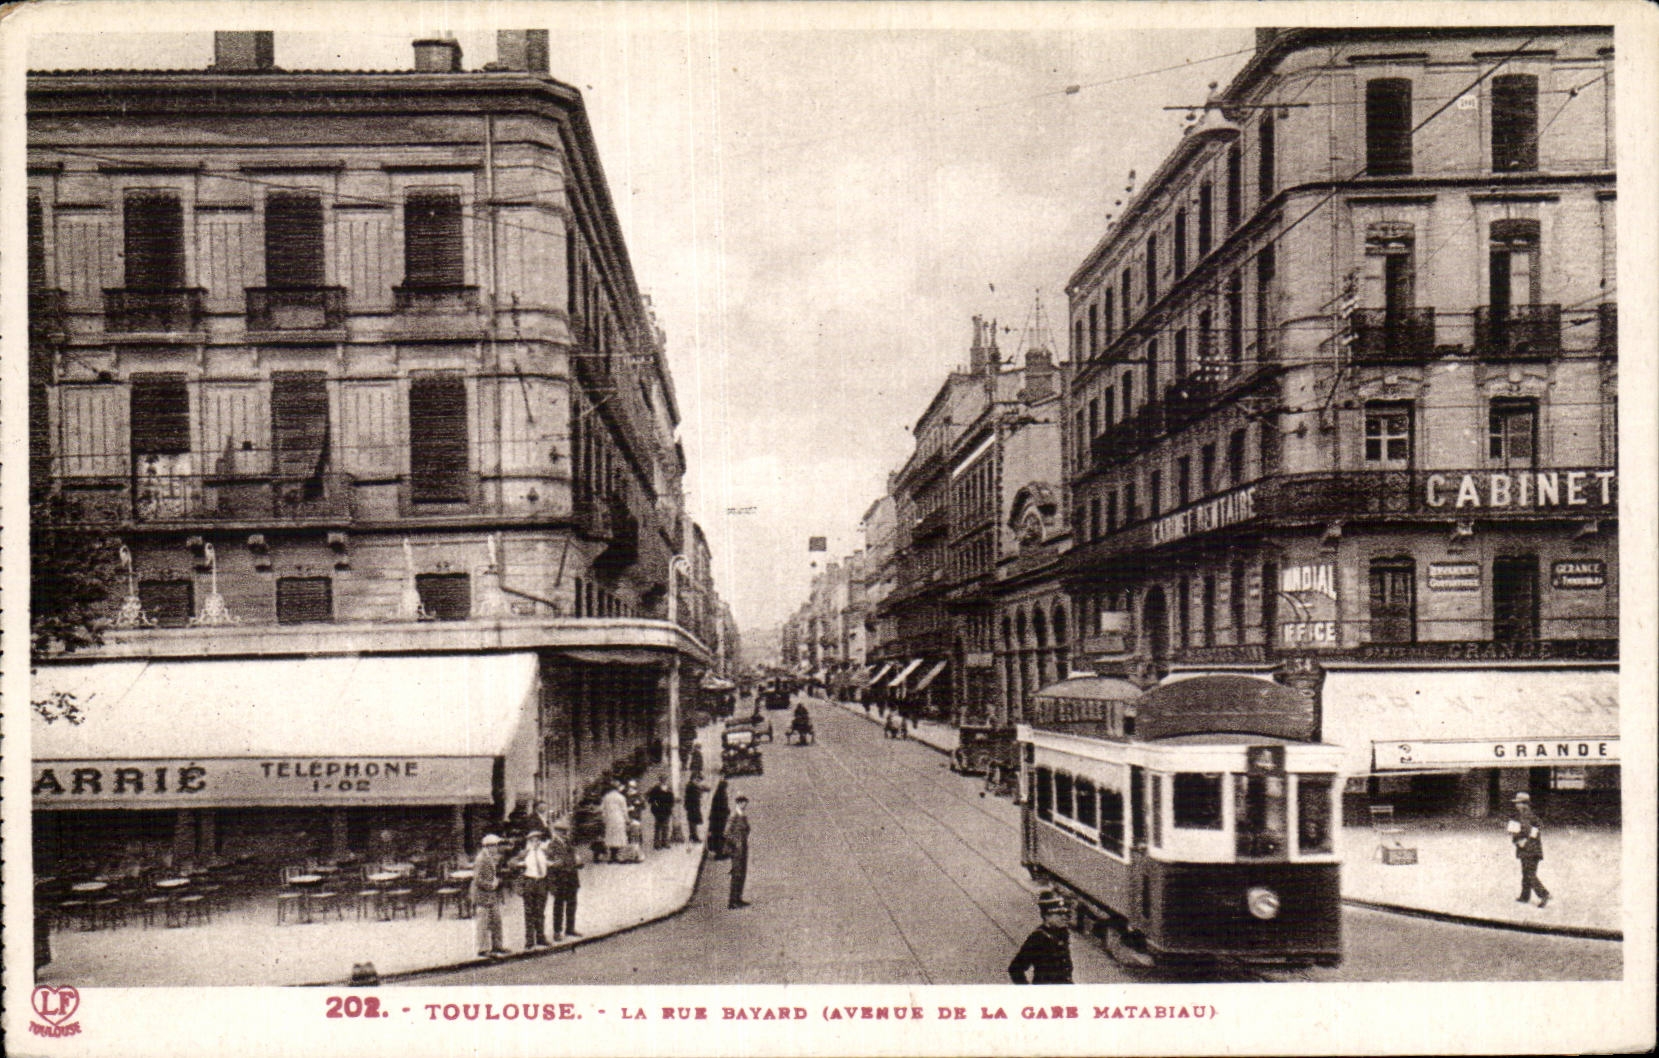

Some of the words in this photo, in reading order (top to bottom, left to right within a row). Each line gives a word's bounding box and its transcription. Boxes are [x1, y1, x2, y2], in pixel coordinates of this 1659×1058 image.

[1426, 471, 1615, 508] CABINET
[1494, 743, 1608, 758] GRANDE
[31, 762, 207, 795] ARRIÉ
